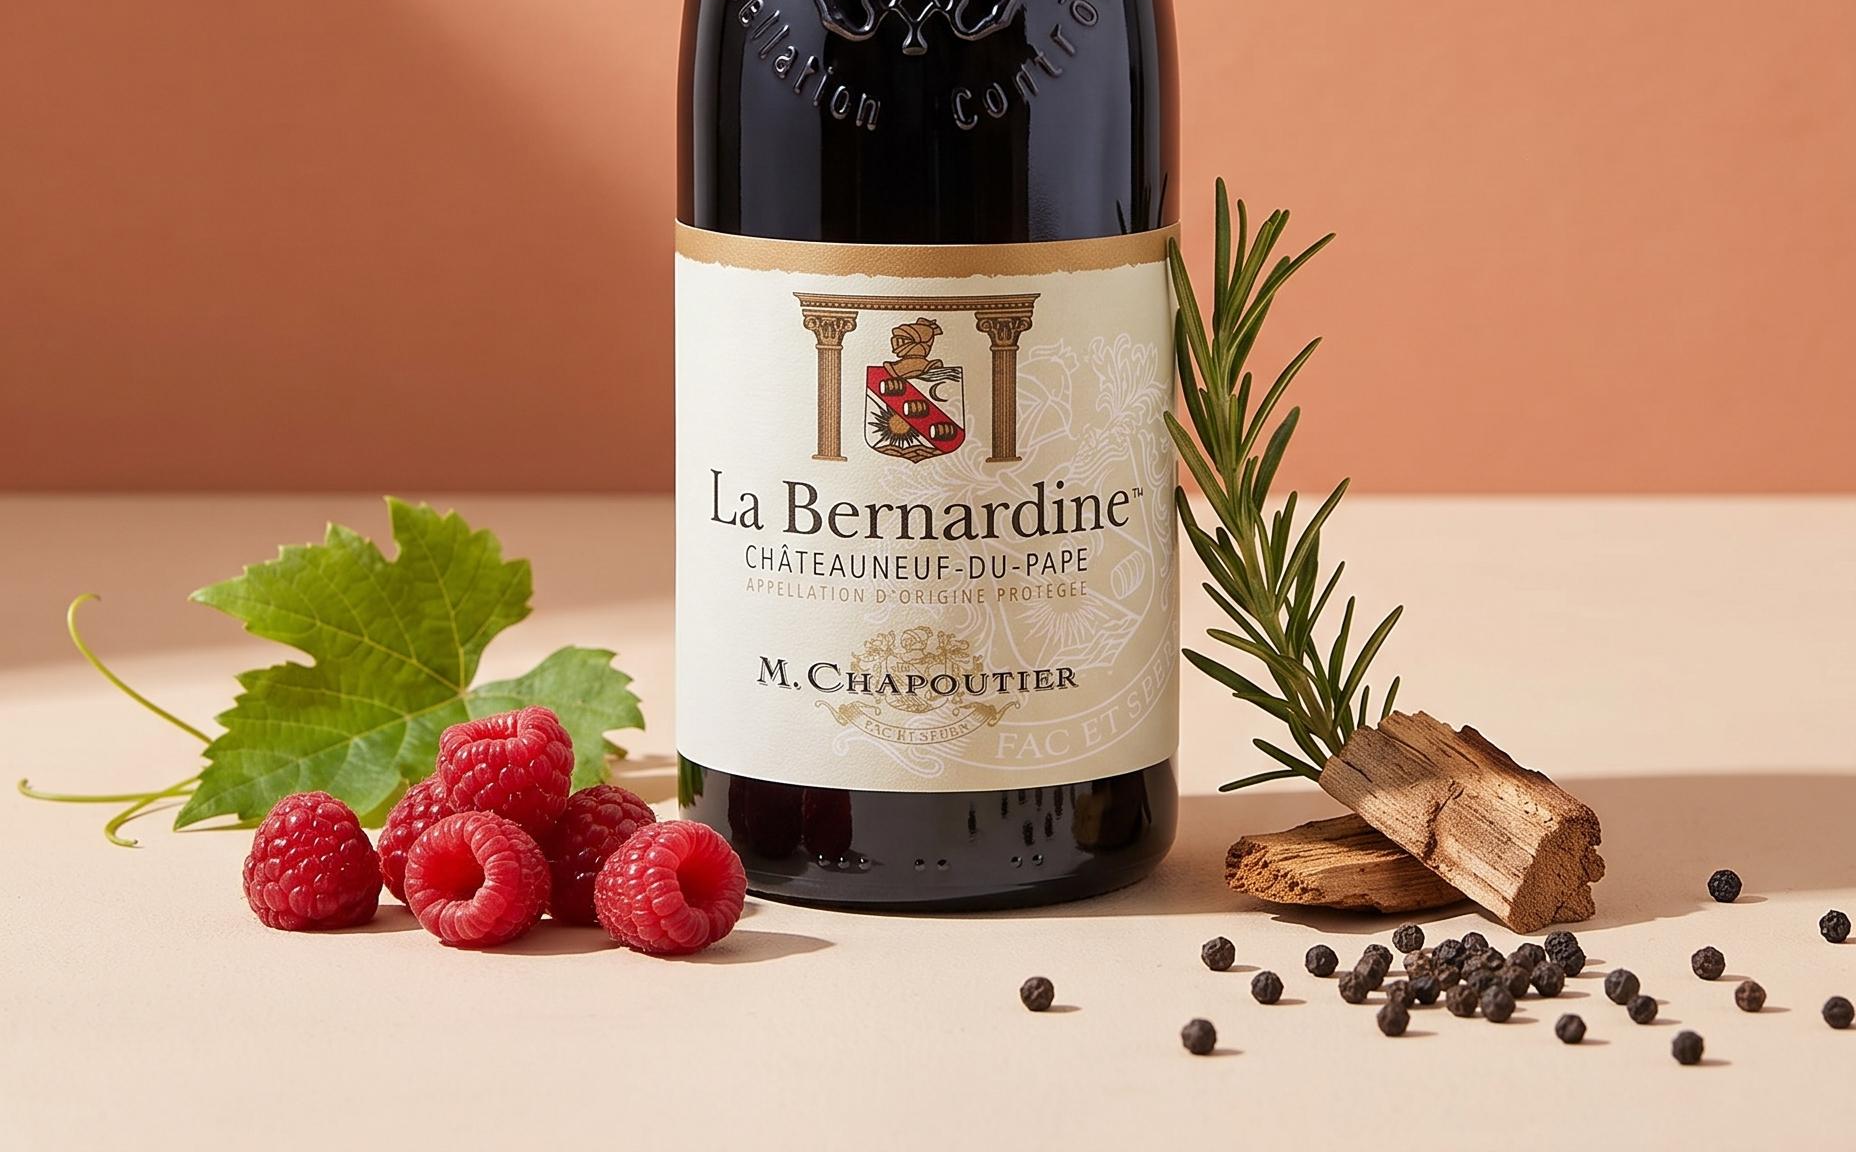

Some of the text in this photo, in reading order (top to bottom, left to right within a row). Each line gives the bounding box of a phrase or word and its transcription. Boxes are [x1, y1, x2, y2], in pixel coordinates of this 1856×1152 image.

[709, 468, 764, 531] La
[745, 543, 1088, 581] CHÂTEAUNEUF-DU-PAPE
[746, 577, 865, 603] APPELLATION
[757, 656, 1080, 697] M. CHAPOUTIER
[994, 728, 1071, 760] FAC
[1082, 705, 1120, 748] ET
